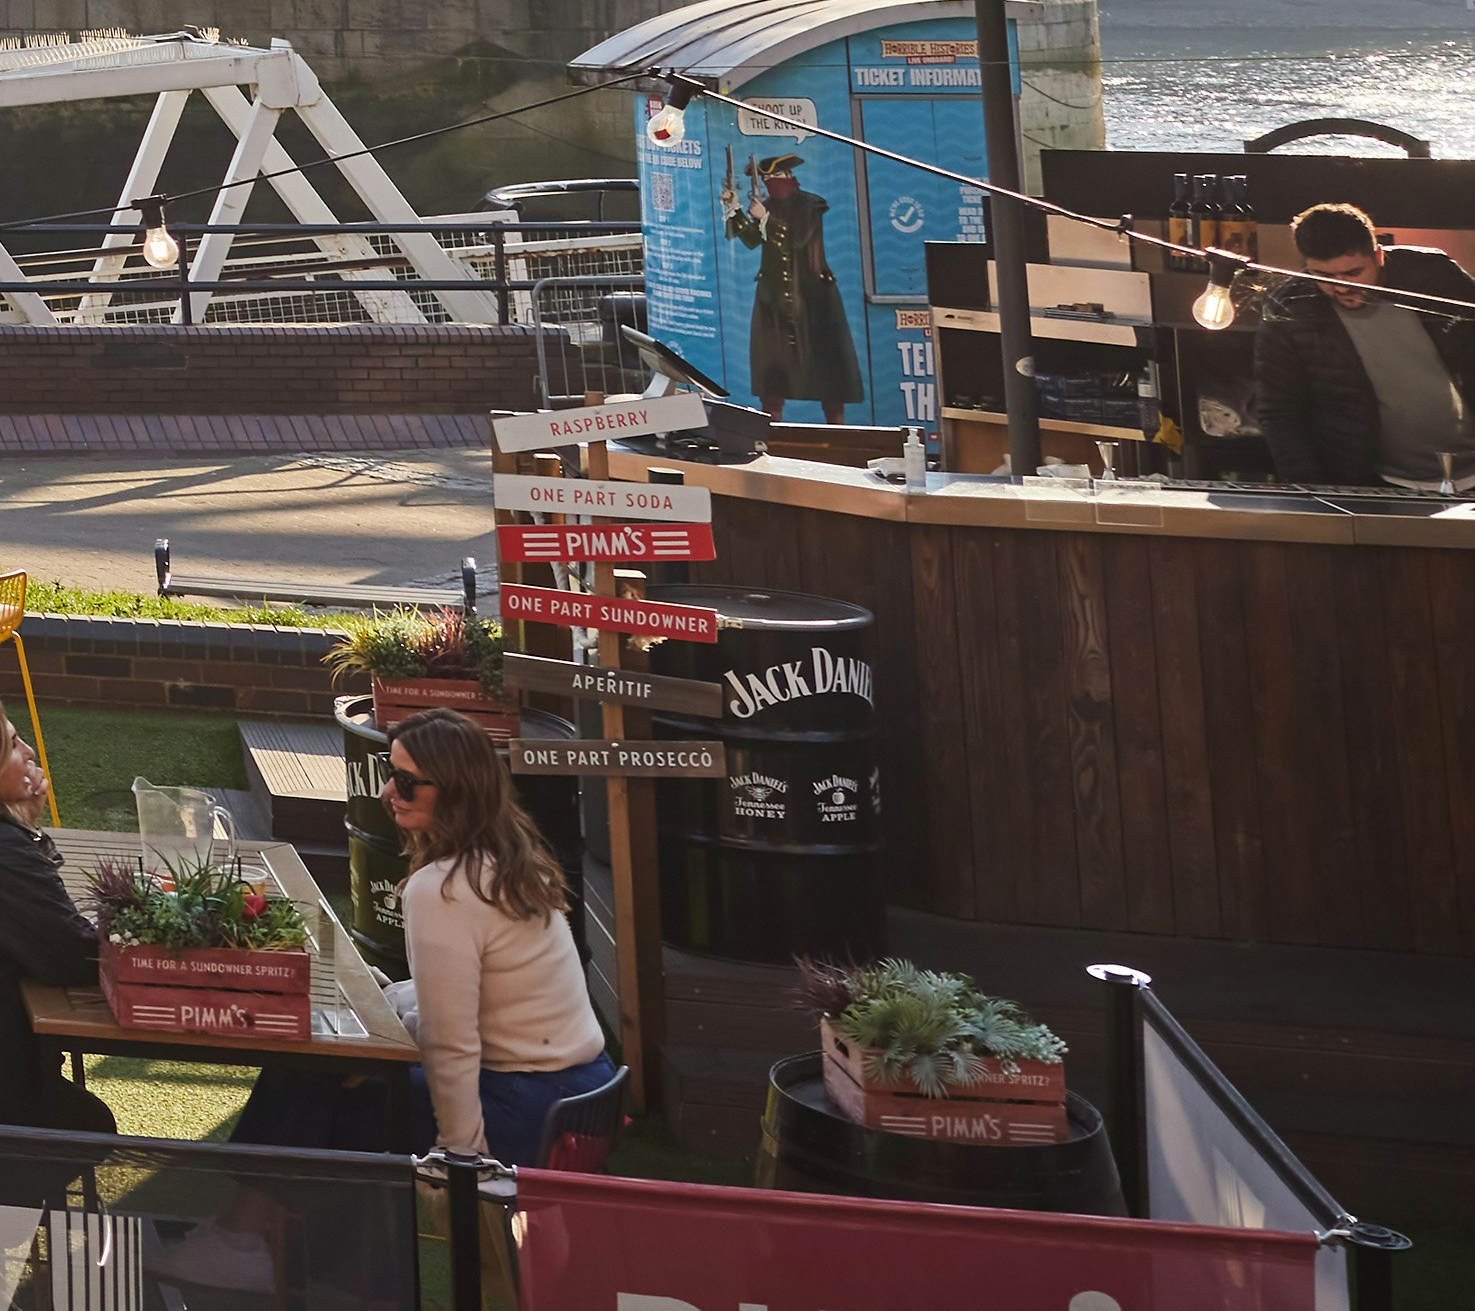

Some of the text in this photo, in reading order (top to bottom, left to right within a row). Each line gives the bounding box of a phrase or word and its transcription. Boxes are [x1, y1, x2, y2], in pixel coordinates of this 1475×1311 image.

[884, 42, 976, 55] HORRIBLE HISTORIES
[854, 68, 906, 86] TICKET
[789, 104, 803, 116] UP
[750, 118, 771, 130] THE
[678, 157, 703, 170] BELOW
[550, 410, 650, 437] RASPBERRY
[530, 487, 674, 510] ONE PART SODA
[565, 526, 647, 557] PIMM'S
[508, 595, 709, 634] ONE PART SUNDOWNER
[385, 685, 402, 696] TIME
[404, 687, 420, 697] FOR
[422, 688, 428, 697] A
[430, 689, 476, 701] SUNDOWNER
[572, 673, 653, 699] APERITIF
[724, 660, 813, 719] JACK
[523, 750, 713, 768] ONE PART PROSECCO
[729, 771, 789, 794] JACK DANIEL'S
[812, 777, 833, 796] JACK
[734, 796, 786, 811] Tennessee
[735, 807, 786, 820] HONEY
[822, 812, 857, 823] APPLE
[132, 957, 296, 977] TIME FOR A SUNDOWNER SPRITZ?
[180, 1004, 250, 1027] PIMM'S
[932, 1115, 1002, 1139] PIMM'S
